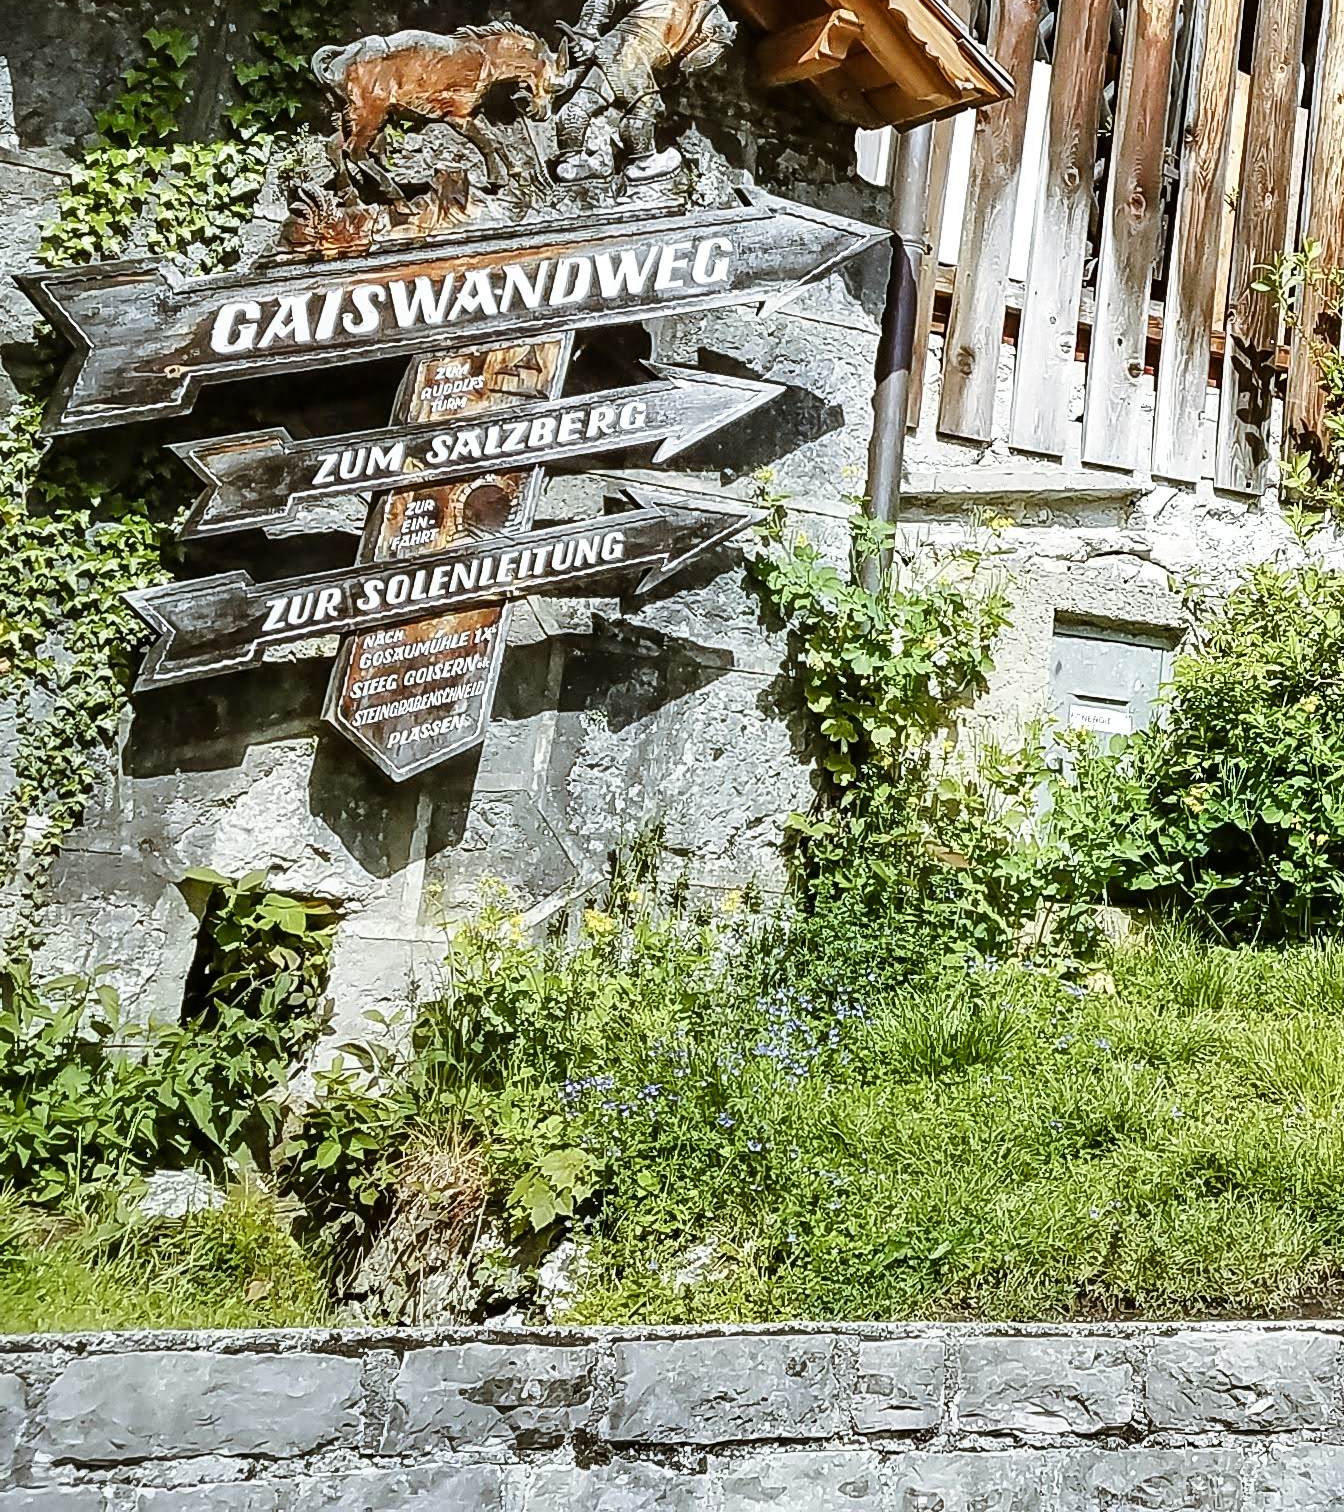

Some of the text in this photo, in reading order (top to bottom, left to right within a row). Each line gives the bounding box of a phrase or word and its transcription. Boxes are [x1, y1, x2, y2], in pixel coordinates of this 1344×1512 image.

[210, 238, 734, 356] GAISWANDWEG
[435, 363, 470, 380] ZUM
[431, 396, 467, 412] TURM
[312, 402, 648, 485] ZUM SALZBERG
[405, 499, 436, 516] ZUR
[401, 515, 436, 534] EIN-
[391, 528, 440, 551] FAHRT
[261, 531, 626, 632] ZUR SOLENLEITUNG
[363, 630, 405, 649] NACH
[350, 674, 399, 699] STEEG
[404, 653, 477, 686] GOISERN
[387, 713, 466, 748] PLASSEN
